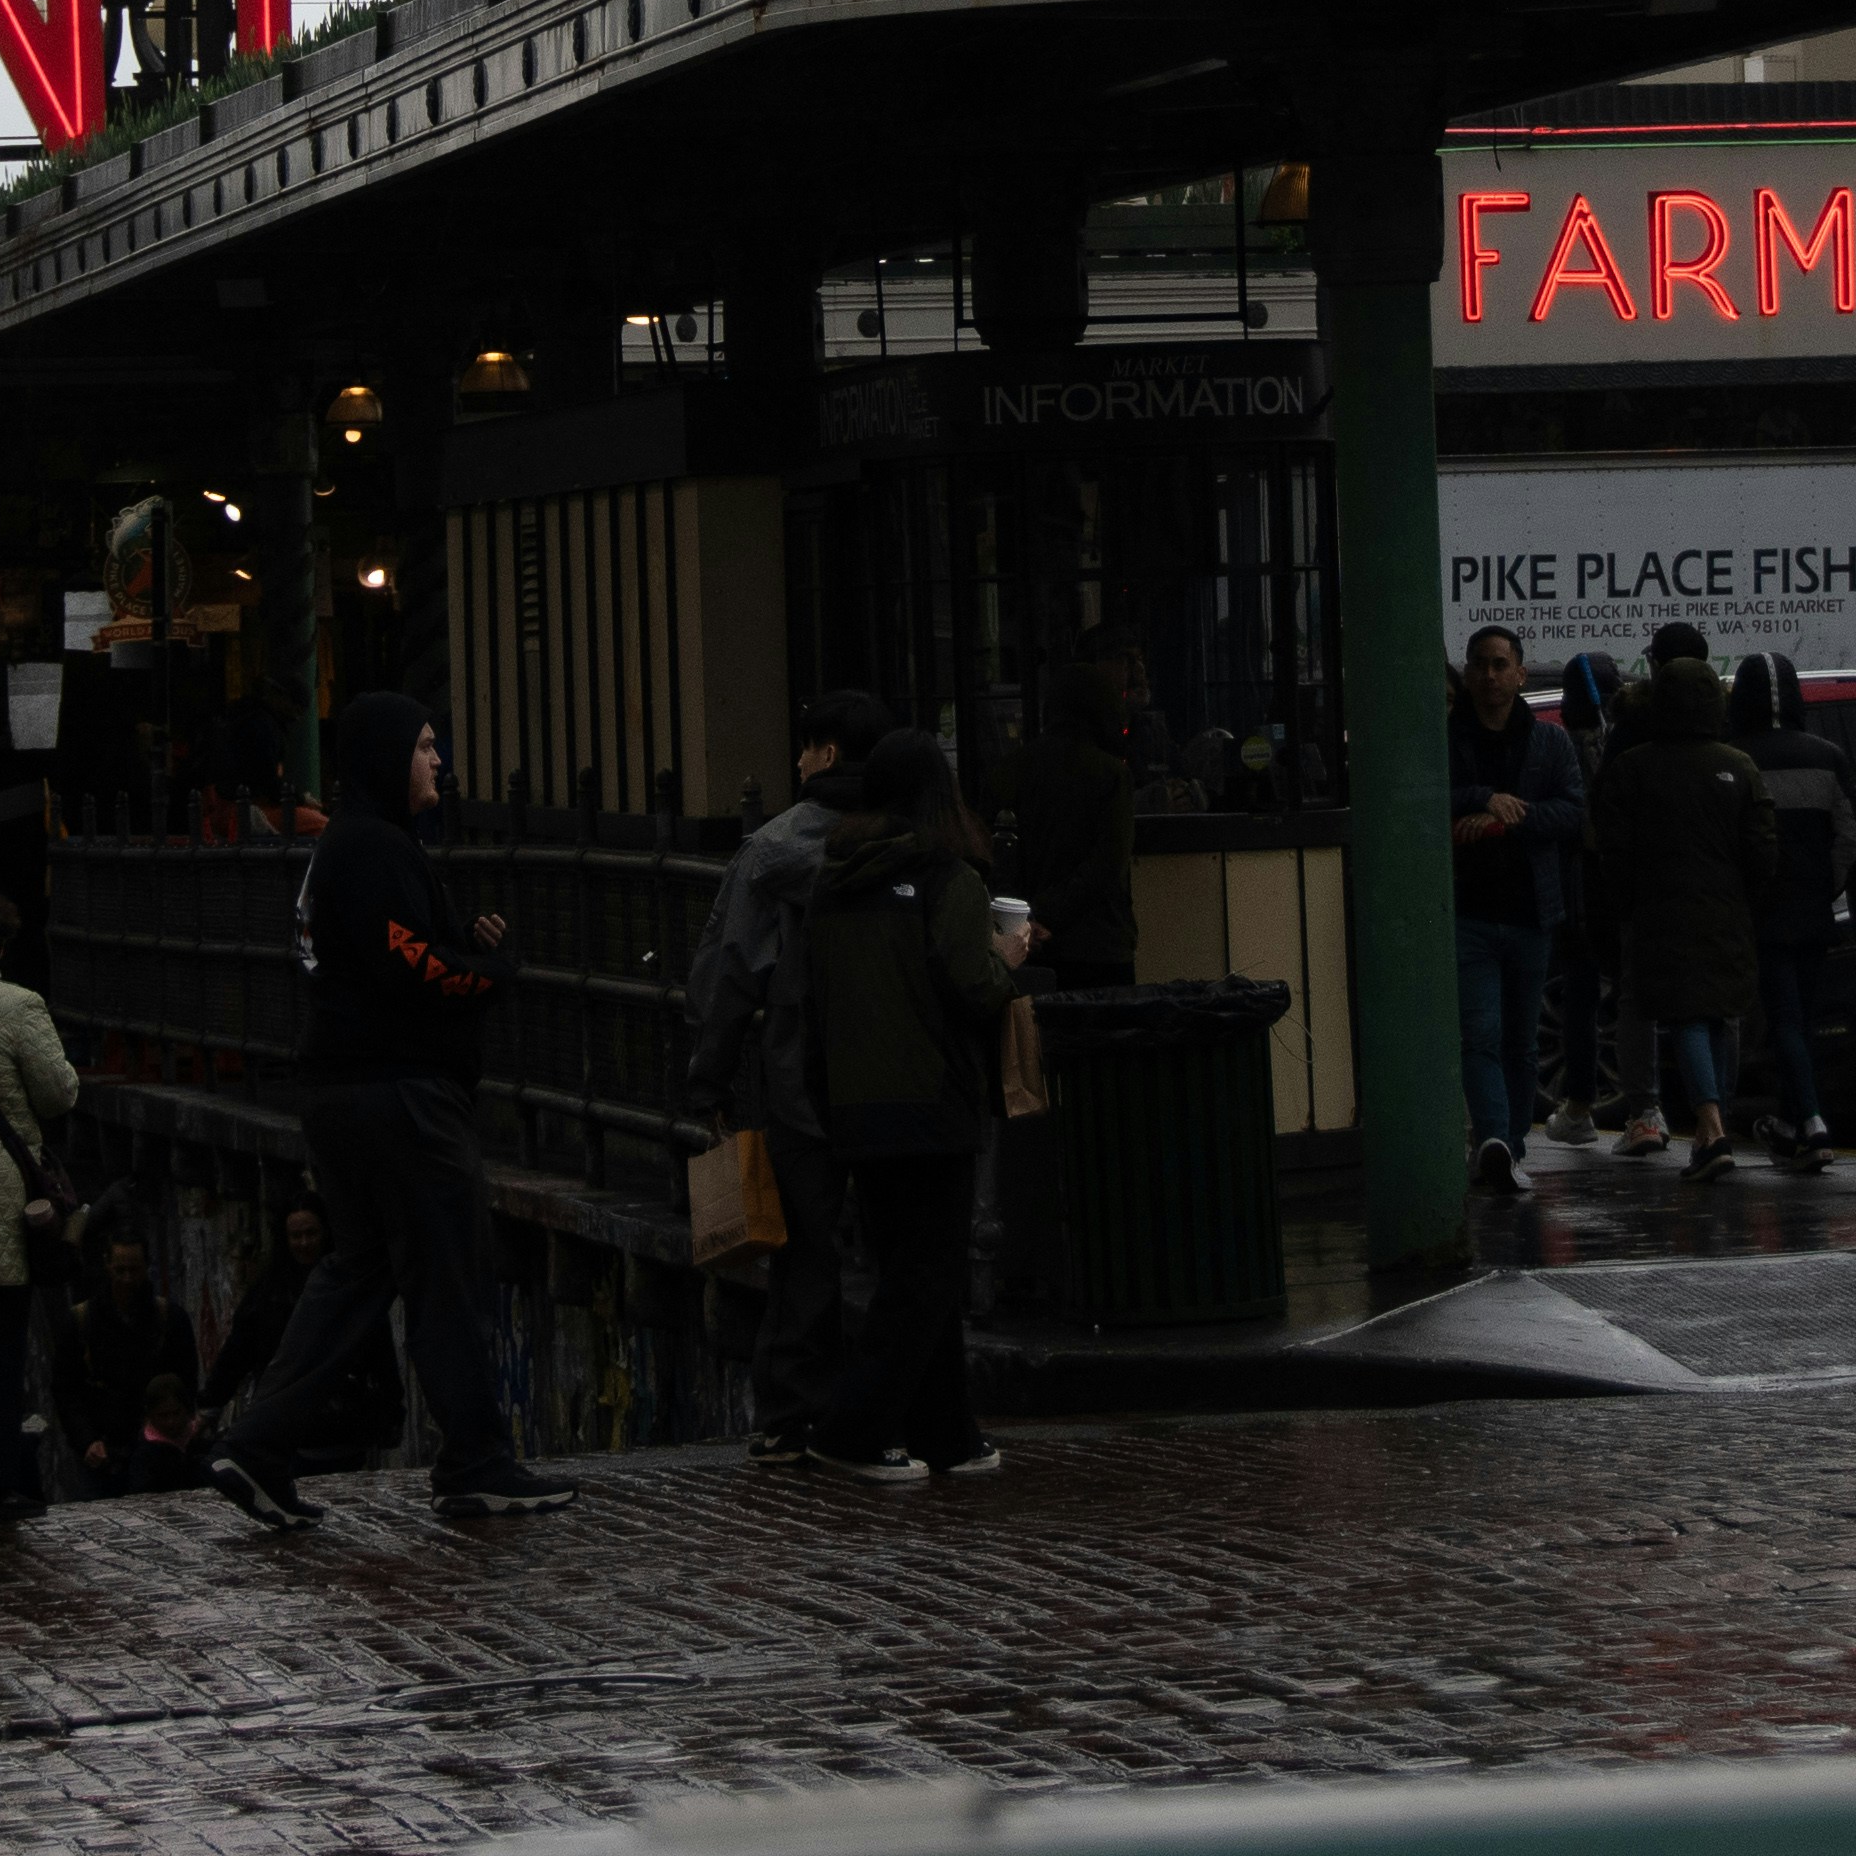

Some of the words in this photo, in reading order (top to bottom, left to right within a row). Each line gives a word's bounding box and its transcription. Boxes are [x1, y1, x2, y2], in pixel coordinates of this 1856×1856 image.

[1111, 355, 1210, 378] MARKET
[819, 376, 909, 448] INFORMATION
[983, 376, 1304, 425] INFORMATION
[1452, 554, 1557, 602] PIKE
[1577, 550, 1733, 599] PLACE
[1468, 607, 1525, 622] UNDER
[1531, 606, 1563, 621] THE
[1567, 605, 1621, 620] CLOCK
[1626, 604, 1643, 619] IN
[1648, 603, 1679, 618] THE
[1685, 601, 1720, 617] PIKE
[1724, 600, 1775, 615] PLACE
[1779, 598, 1845, 614] MARKET
[1542, 624, 1576, 639] PIKE
[1581, 623, 1637, 641] PLACE,
[1717, 619, 1744, 635] WA
[1751, 618, 1801, 634] 98101
